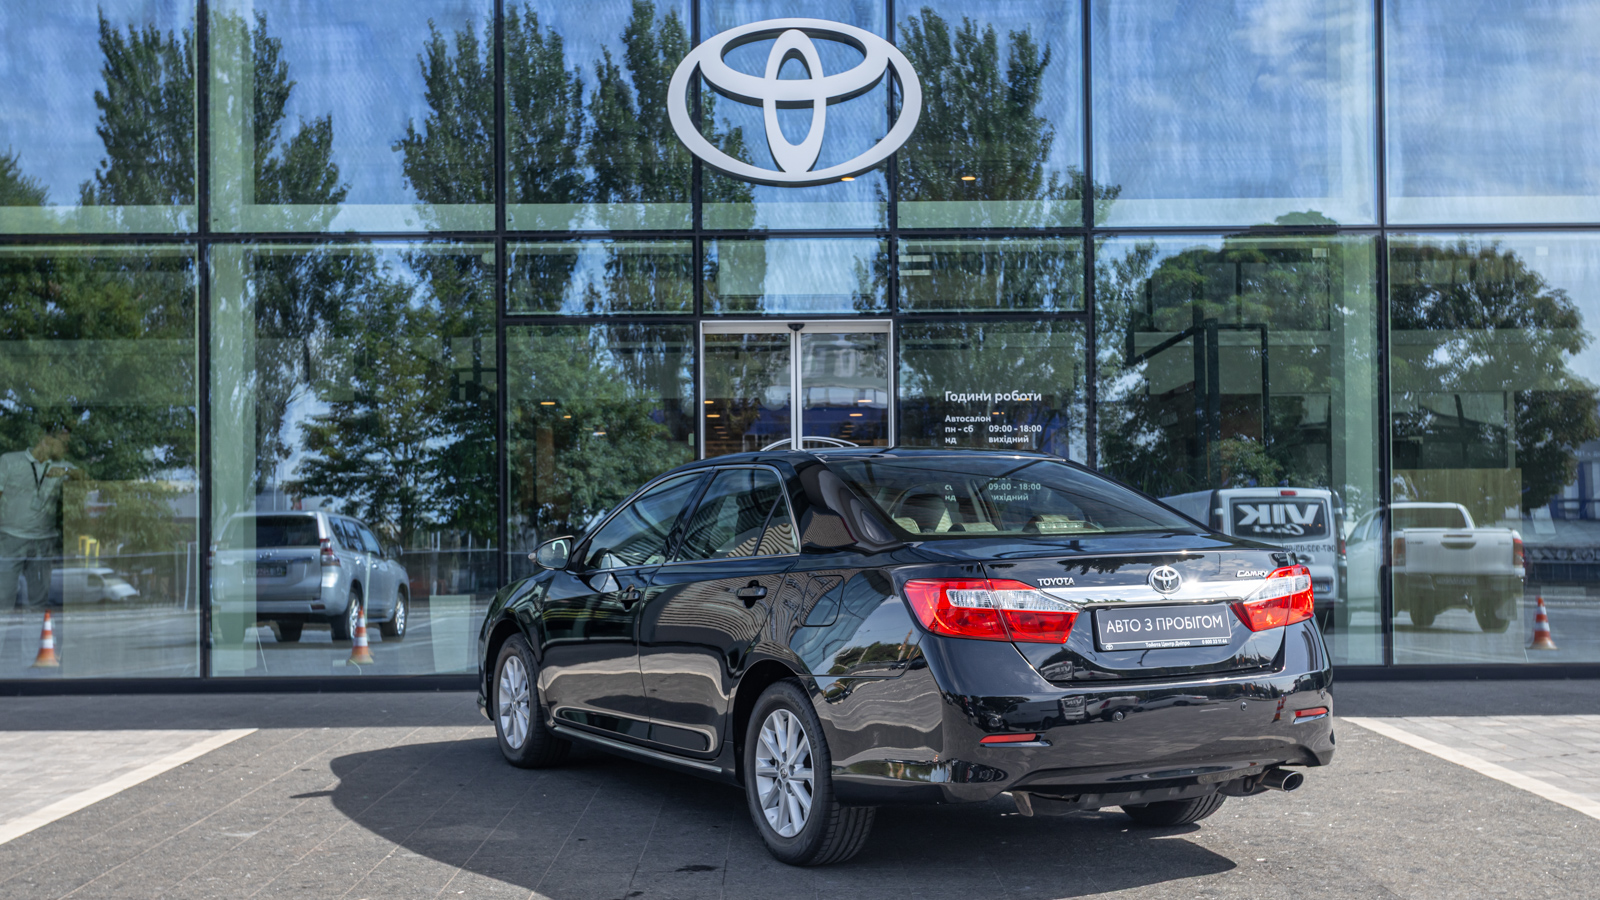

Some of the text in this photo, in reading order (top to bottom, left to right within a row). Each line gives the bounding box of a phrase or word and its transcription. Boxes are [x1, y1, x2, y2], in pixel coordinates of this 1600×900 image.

[945, 390, 1042, 404] Години роботи
[945, 415, 992, 423] Автосалон
[963, 425, 974, 433] сб
[988, 425, 1012, 433] 09:00
[1020, 425, 1042, 433] 18:00
[945, 434, 1029, 445] нд вихідний
[988, 483, 1012, 491] 09:00
[1020, 483, 1042, 491] 18:00
[1037, 577, 1075, 586] TOYOTA
[1106, 618, 1141, 633] АВТО
[1156, 615, 1223, 631] ПРОБІГОМ
[787, 692, 806, 716] Sport
